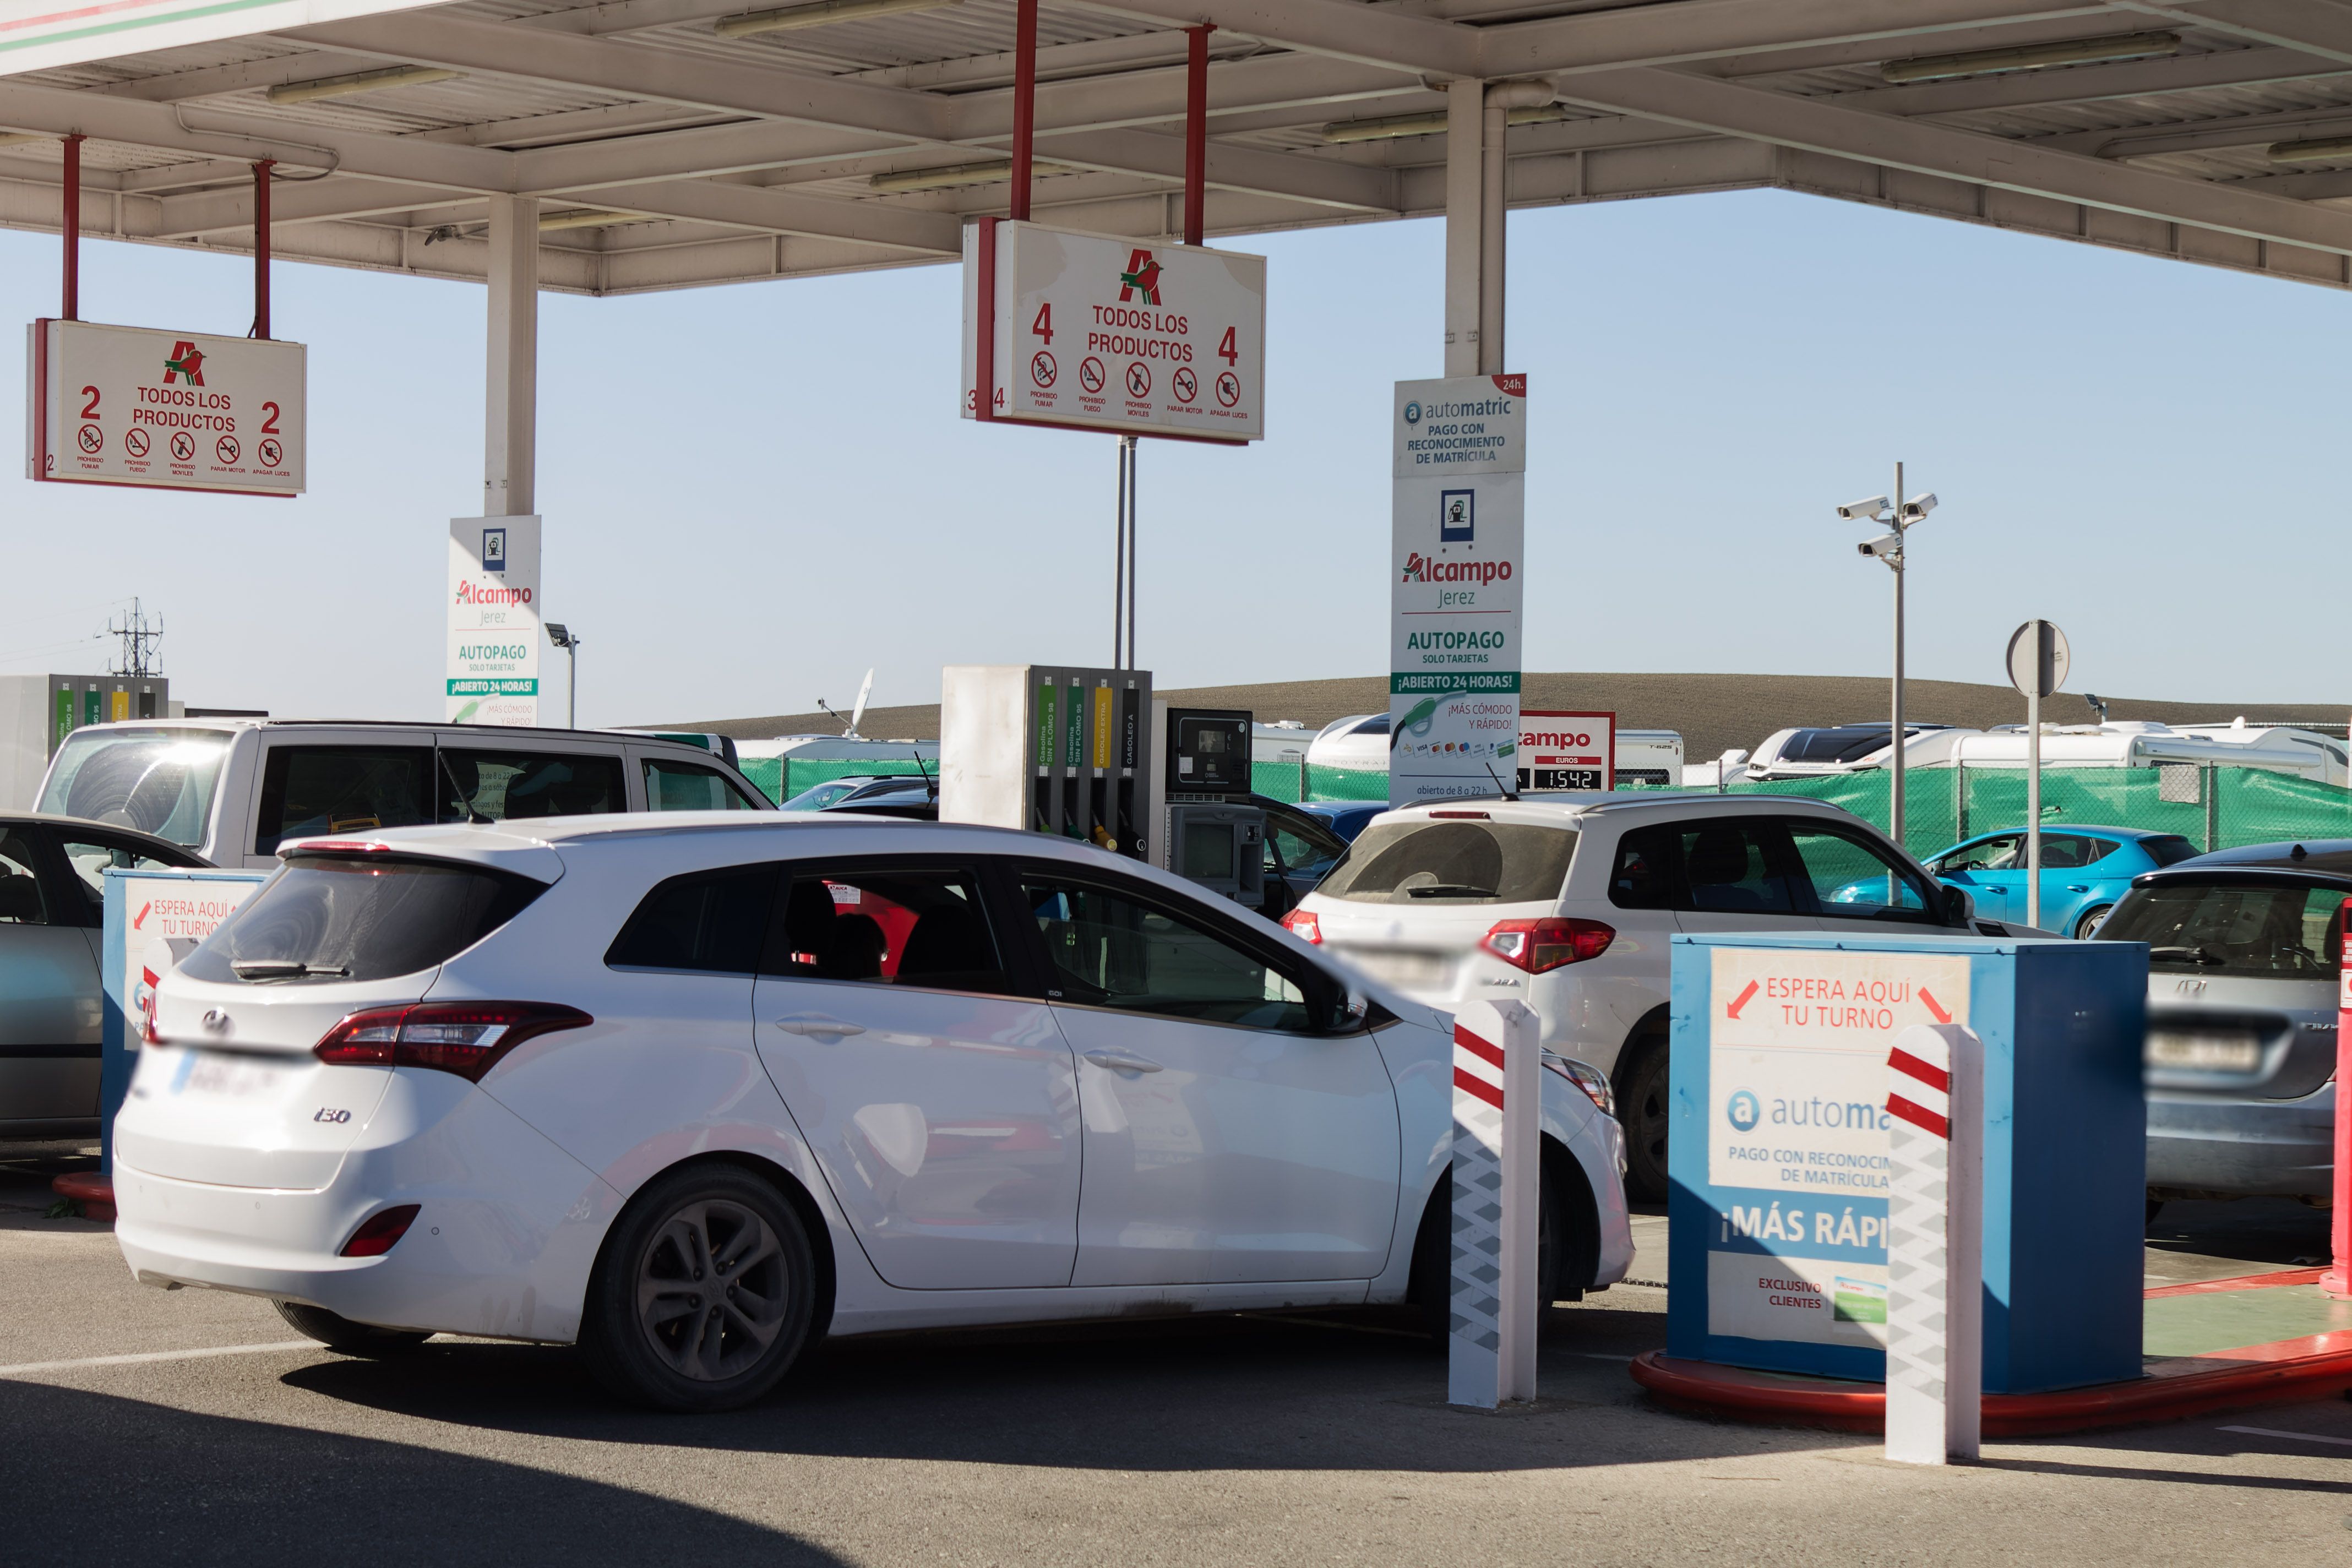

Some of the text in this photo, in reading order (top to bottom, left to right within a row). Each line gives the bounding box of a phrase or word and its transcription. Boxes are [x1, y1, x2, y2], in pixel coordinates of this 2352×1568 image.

[1032, 303, 1054, 345] 4
[1092, 305, 1188, 335] TODOS LOS
[1088, 332, 1193, 362] PRODUCTOS
[1218, 326, 1238, 367] 4
[1503, 378, 1523, 390] 24h.
[80, 385, 100, 420] 2
[138, 386, 231, 410] TODOS LOS
[968, 389, 977, 410] 3
[994, 387, 1005, 409] 4
[1030, 391, 1058, 400] PROHIBIDO
[1079, 396, 1106, 405] PROHIBIDO
[1125, 401, 1152, 409] PROHIBIDO
[1426, 396, 1511, 418] automatric
[133, 409, 235, 432] PRODUCTOS
[261, 401, 280, 434] 2
[1428, 423, 1484, 436] PAGO CON
[1408, 435, 1505, 450] RECONOCIMIENTO
[47, 454, 54, 471] 2
[1416, 449, 1496, 464] DE MATRÍCULA
[1402, 552, 1512, 586] Alcampo
[456, 580, 532, 607] Alcampo
[1437, 589, 1475, 608] Jerez
[480, 610, 505, 626] Jerez
[1407, 631, 1504, 650] AUTOPAGO
[459, 645, 526, 660] AUTOPAGO
[1423, 654, 1489, 663] SOLO TARJETAS
[452, 680, 532, 694] ¡ABIERTO 24 HORAS!
[1398, 675, 1512, 692] ¡ABIERTO 24 HORAS!
[487, 704, 532, 715] ¡MÁS CÓMODO
[1048, 703, 1054, 712] 98
[1076, 704, 1082, 713] 95
[1448, 702, 1512, 717] ¡MÁS CÓMODO
[507, 716, 531, 726] RÁPIDO!
[1469, 717, 1511, 729] Y RÁPIDO!
[1417, 744, 1428, 752] VISA
[1550, 771, 1592, 788] 1.542
[1417, 785, 1445, 794] abierto
[1446, 786, 1455, 794] de
[1457, 786, 1462, 794] 8
[1471, 786, 1480, 794] 22
[155, 899, 227, 918] ESPERA AQUÍ
[162, 919, 176, 934] TU
[1767, 977, 1910, 1006] ESPERA AQUÍ
[1782, 1005, 1893, 1030] TU TURNO
[314, 1107, 351, 1124] i30
[1771, 1096, 1890, 1131] automa
[1729, 1146, 1769, 1162] PAGO
[1773, 1150, 1804, 1164] CON
[1781, 1168, 1890, 1188] DE MATRÍCULA
[1721, 1201, 1887, 1249] ¡MÁS RÁPI
[1758, 1277, 1821, 1293] EXCLUSIVO
[1769, 1295, 1821, 1309] CLIENTES
